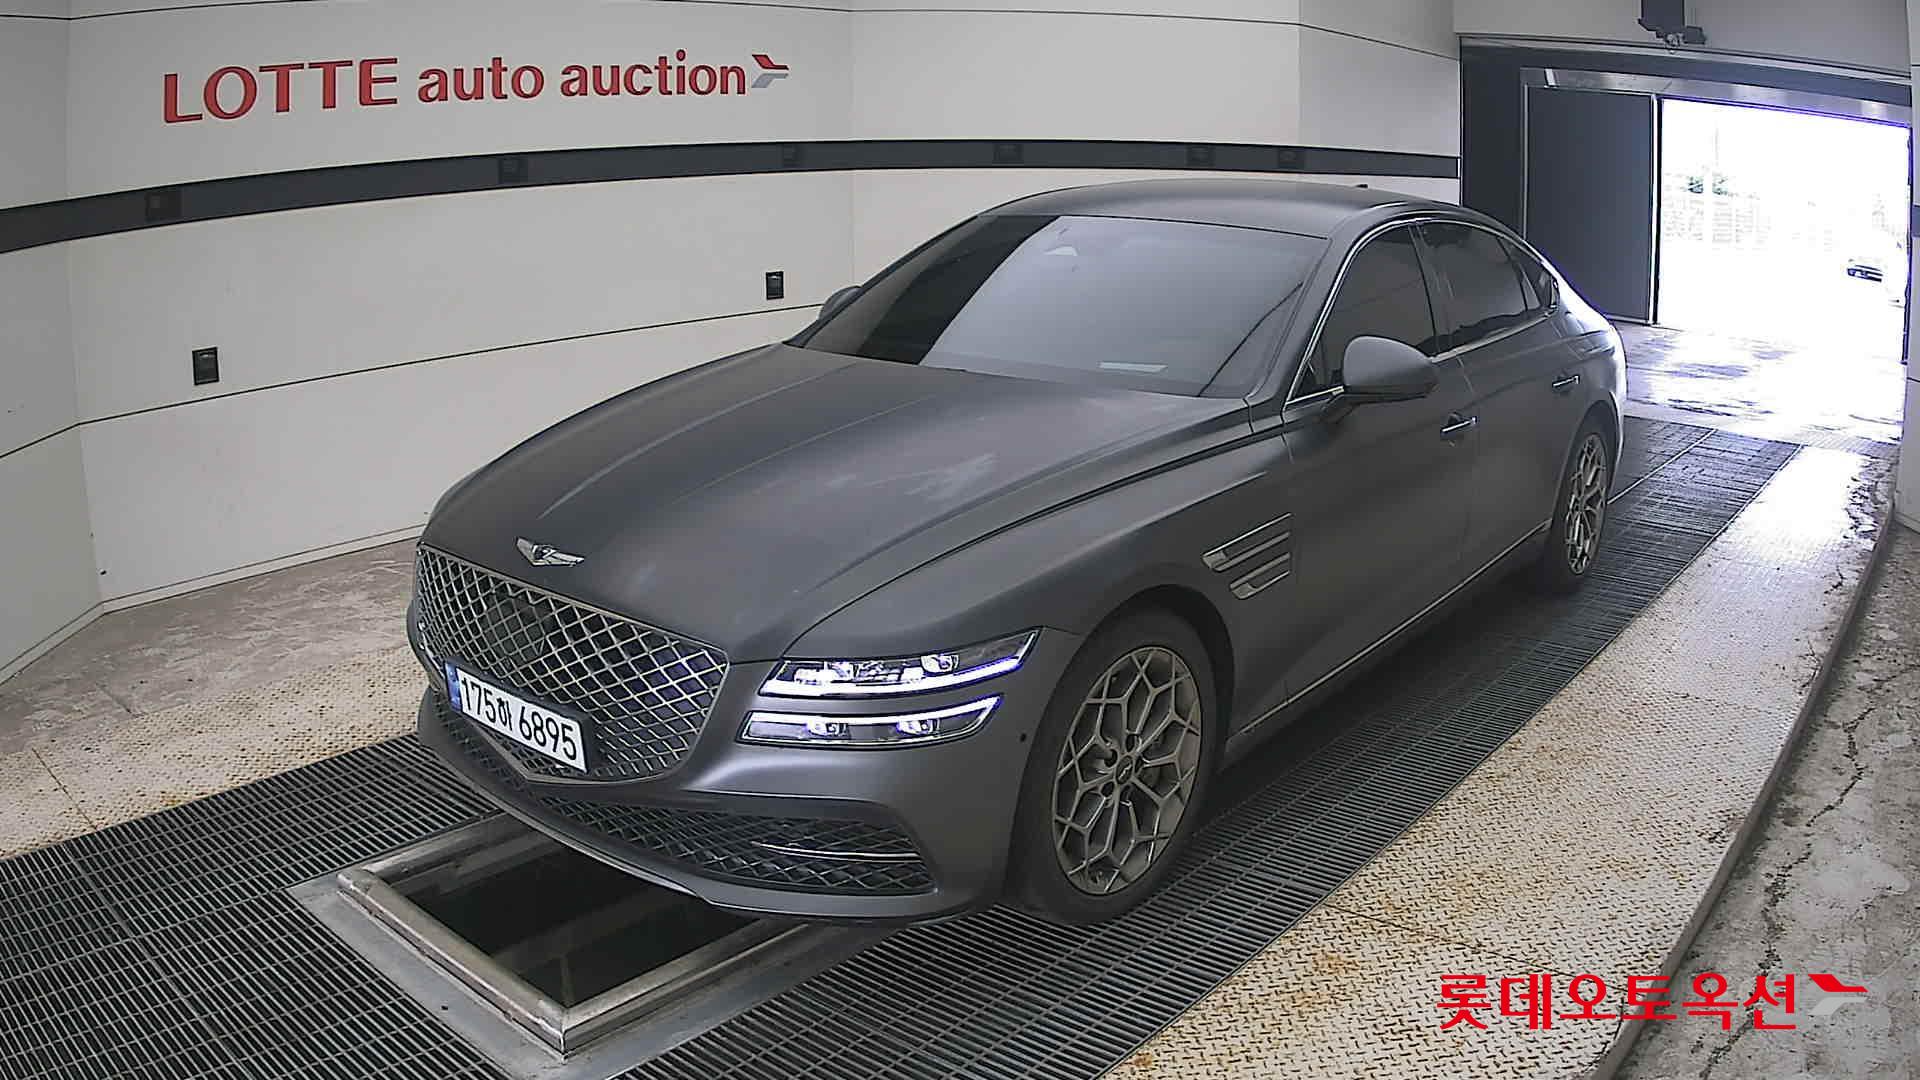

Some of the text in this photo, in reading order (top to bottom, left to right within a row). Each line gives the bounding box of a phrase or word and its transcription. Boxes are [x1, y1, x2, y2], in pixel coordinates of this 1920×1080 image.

[164, 49, 746, 123] LOTTE auto auction
[519, 706, 577, 760] 6895
